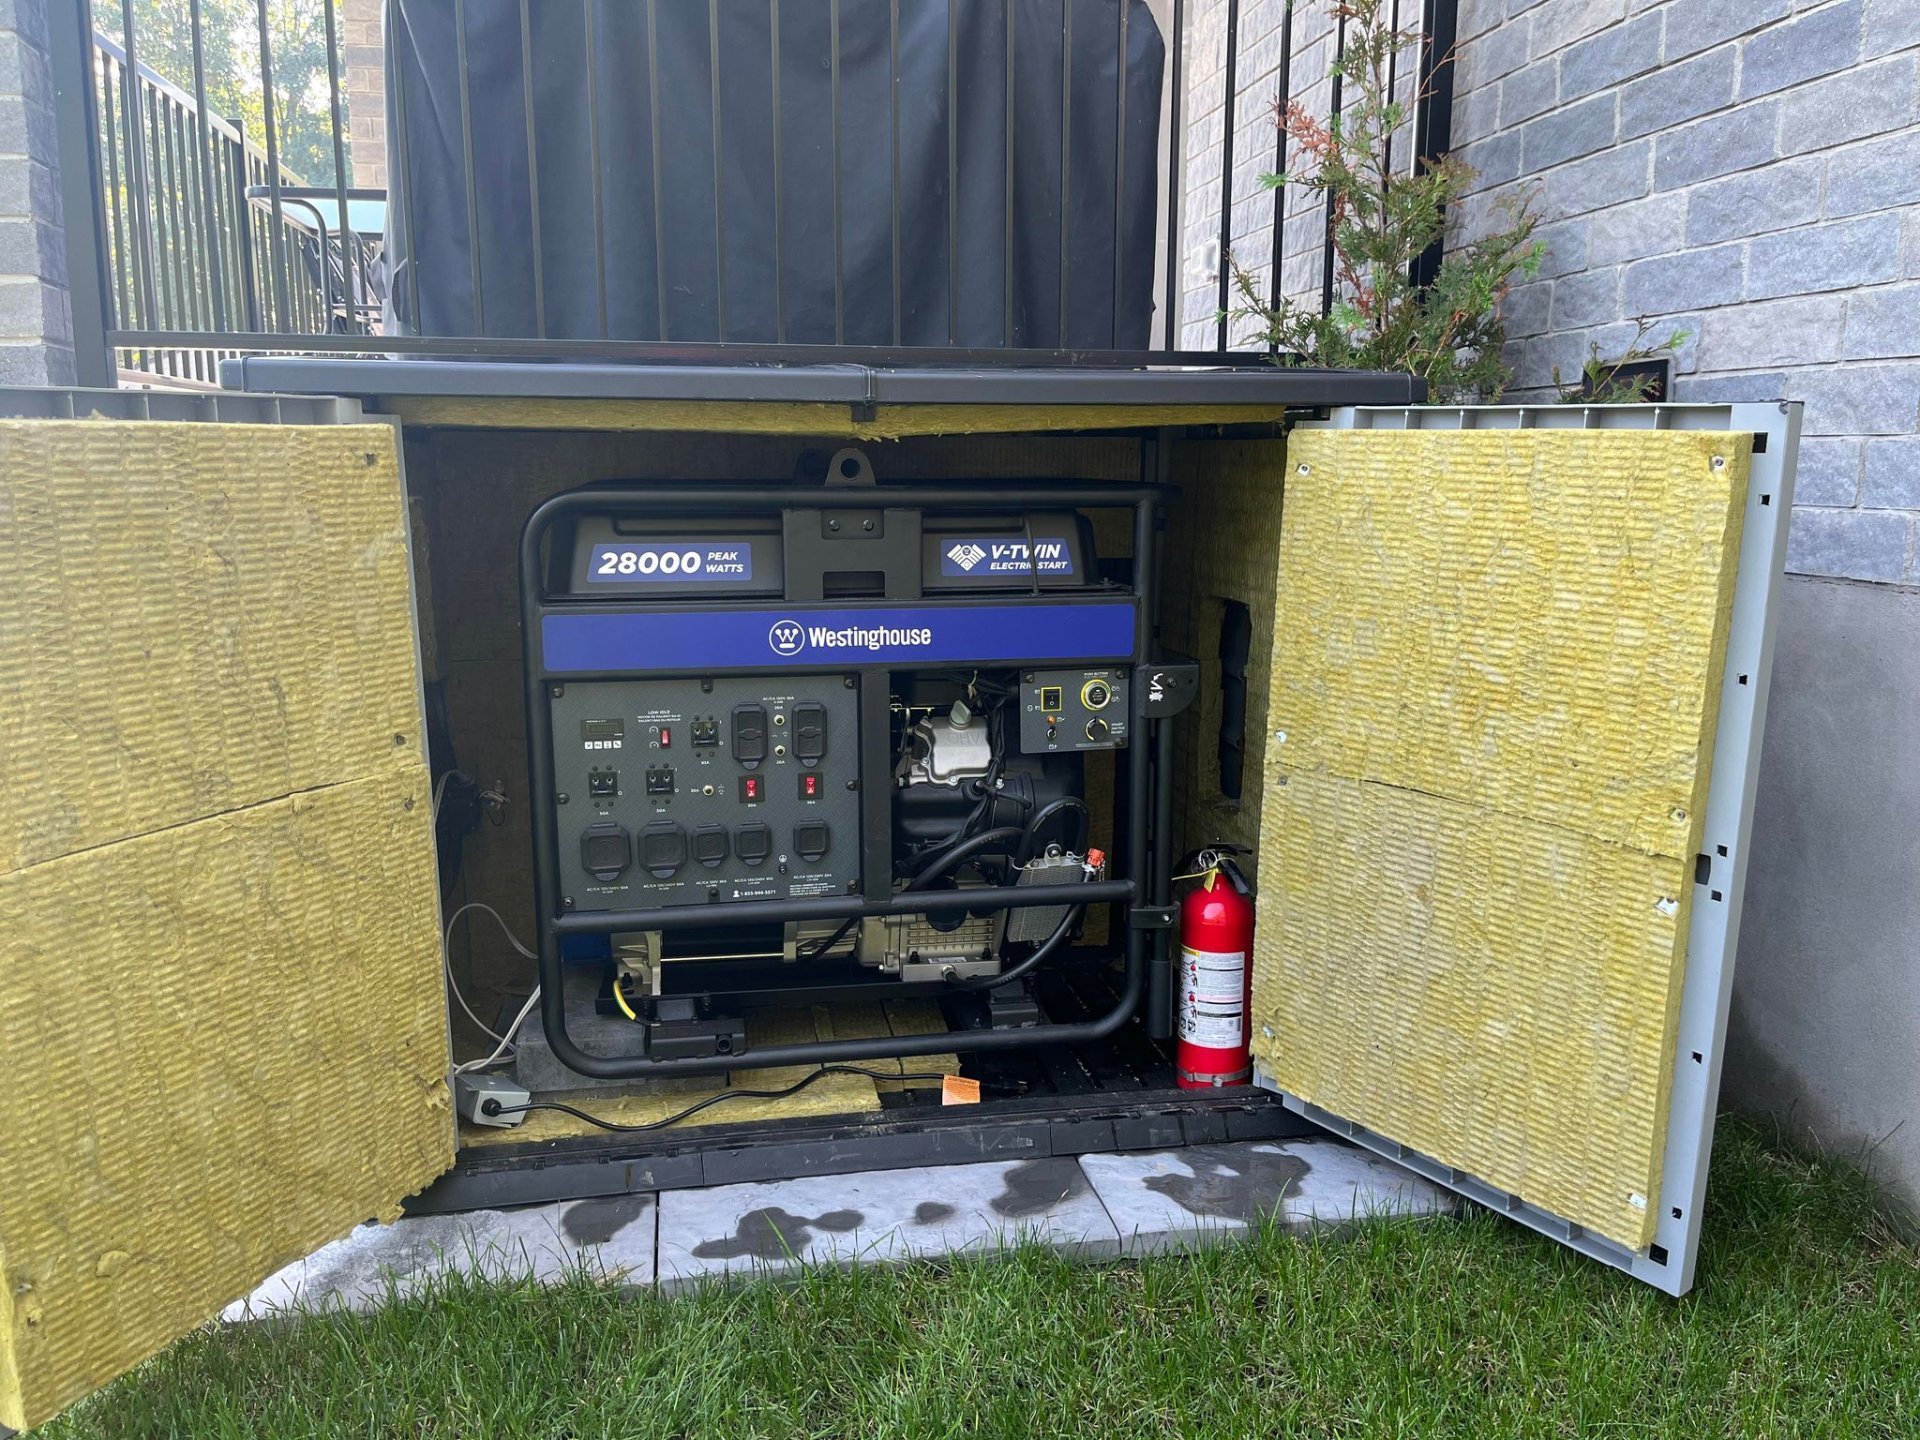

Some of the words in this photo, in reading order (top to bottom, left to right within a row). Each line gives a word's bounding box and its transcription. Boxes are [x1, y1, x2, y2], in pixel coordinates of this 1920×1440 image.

[707, 552, 739, 561] PEAK
[991, 544, 1061, 559] V-TWIN
[598, 551, 701, 574] 28000
[706, 563, 744, 573] WATTS
[990, 561, 1033, 570] ELECTRI
[1037, 561, 1068, 569] START
[808, 625, 932, 650] Westinghouse
